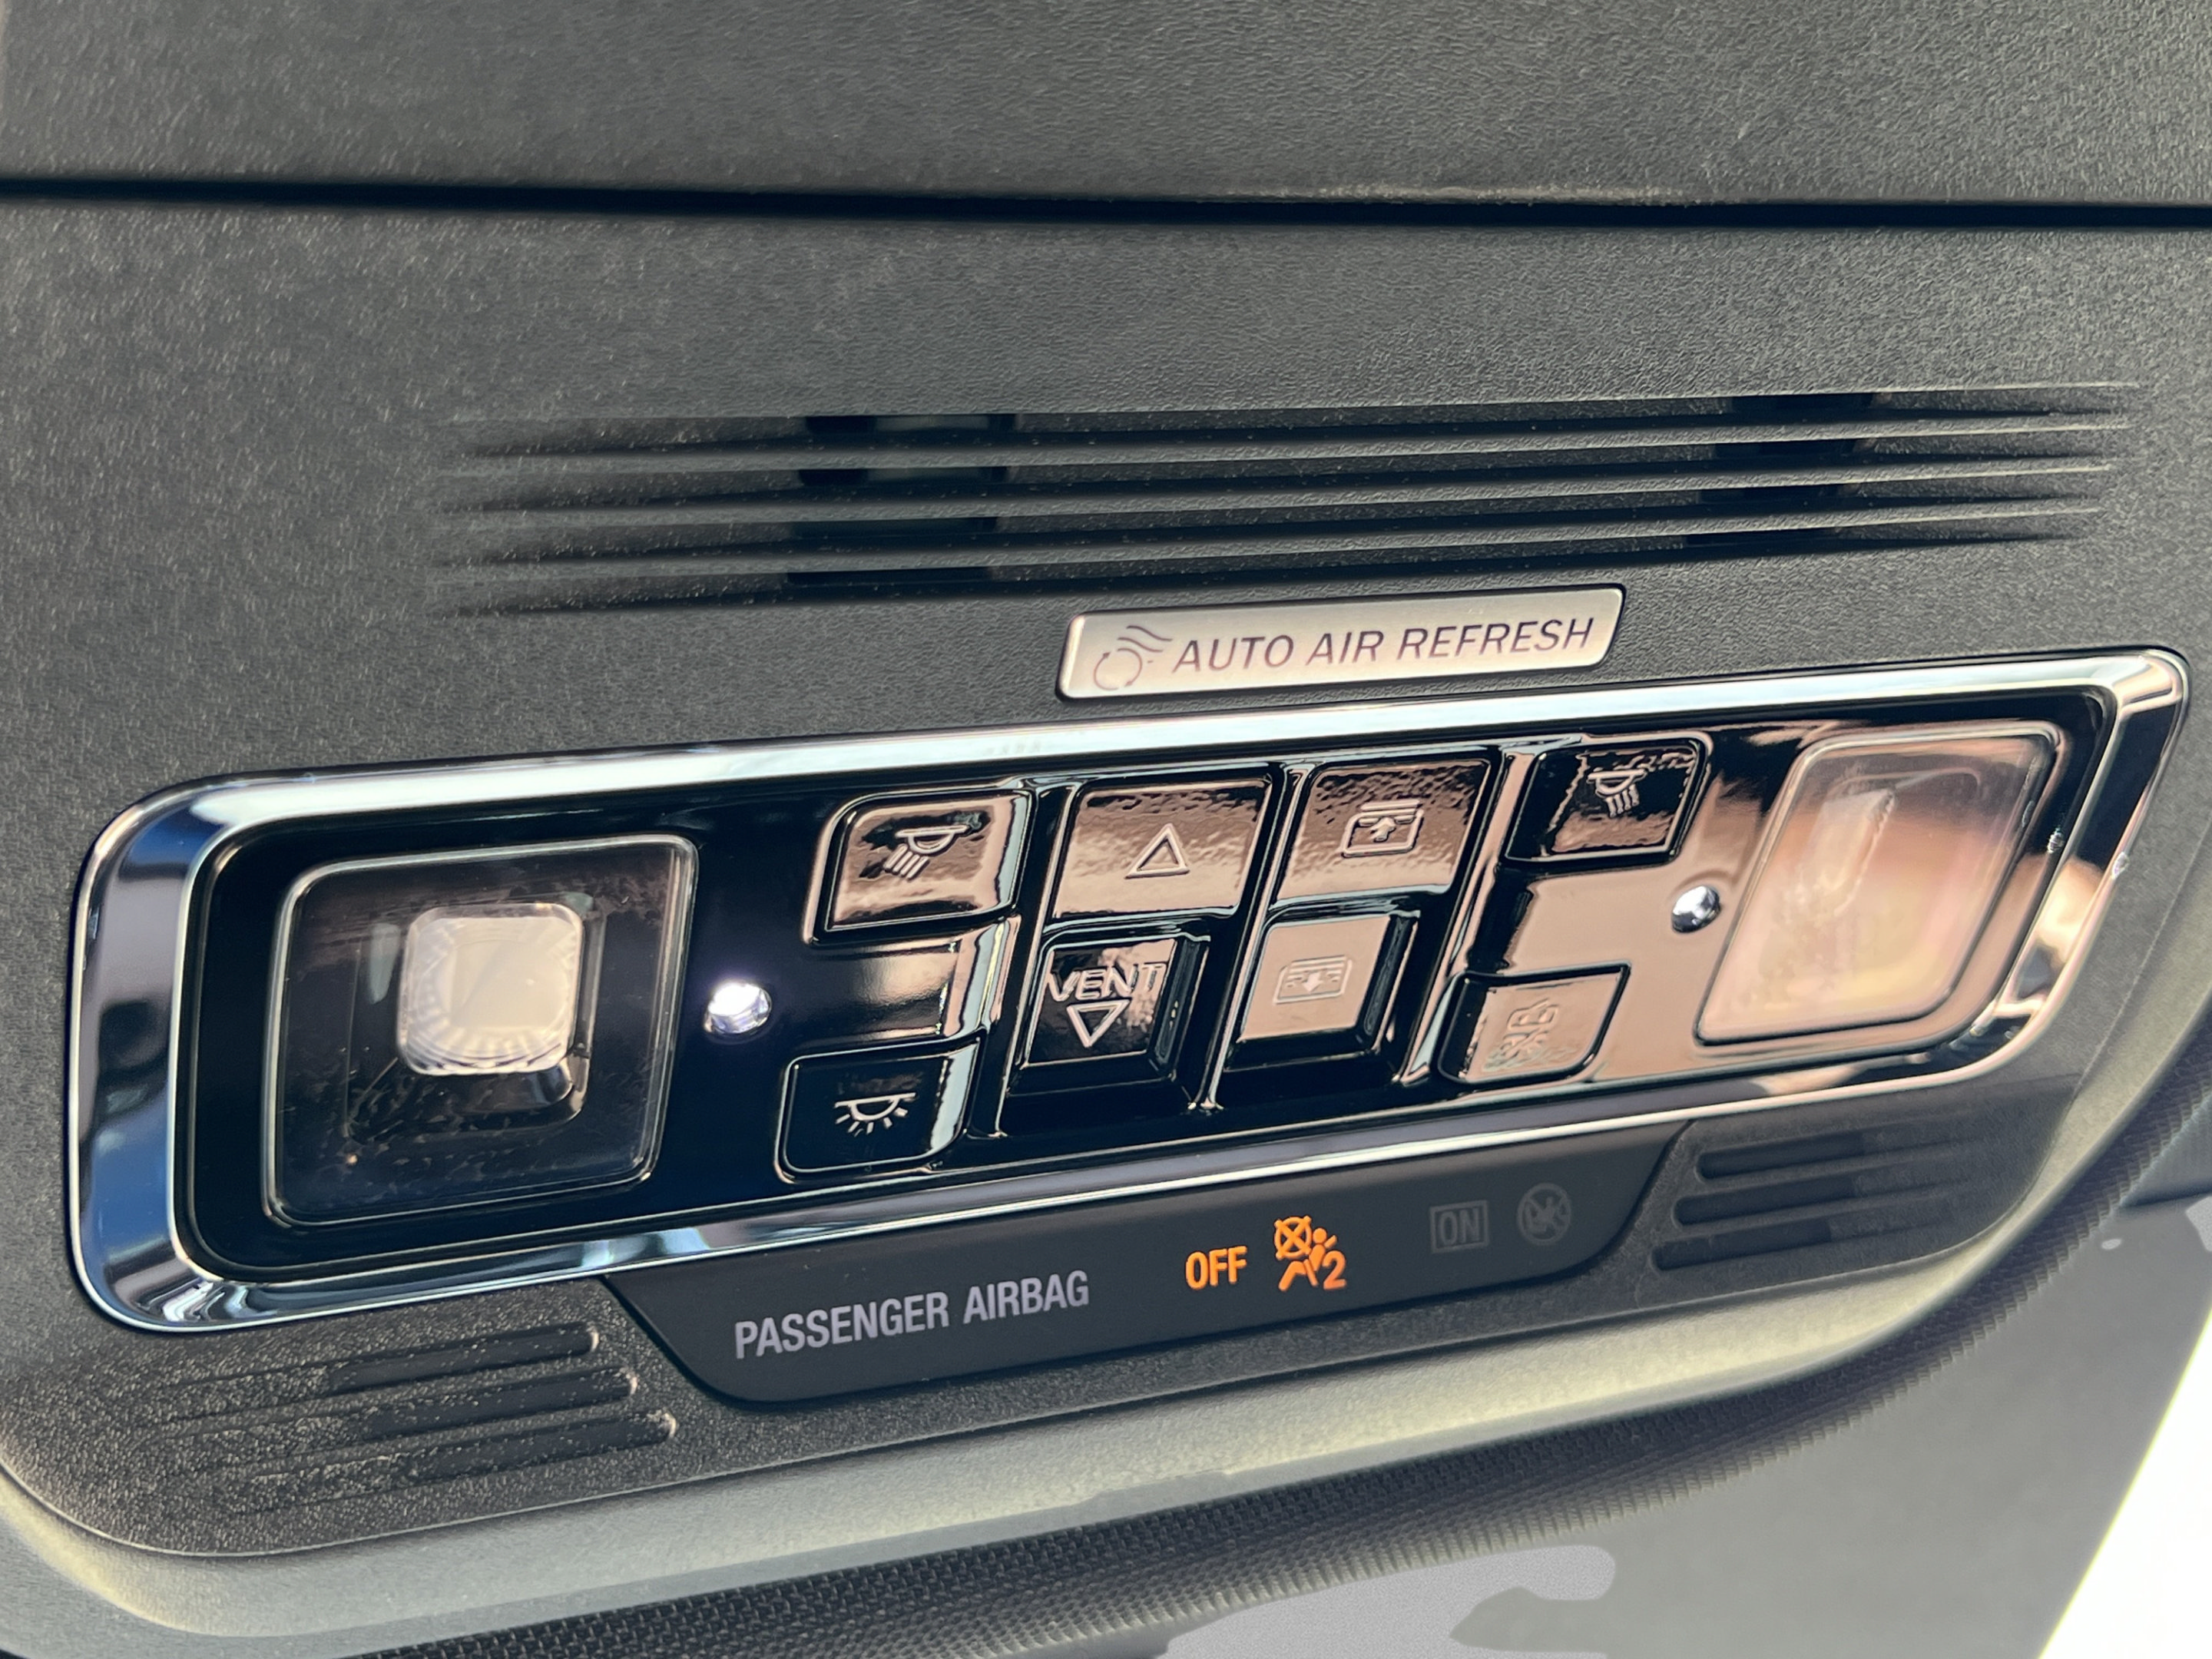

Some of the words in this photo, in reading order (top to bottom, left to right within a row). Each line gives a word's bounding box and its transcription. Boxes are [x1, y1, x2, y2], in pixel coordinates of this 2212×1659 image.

[1173, 634, 1293, 673] AUTO
[1306, 630, 1383, 666] AIR
[1396, 617, 1594, 661] REFRESH
[1050, 962, 1167, 1002] VENT
[1438, 1207, 1482, 1244] ON
[1186, 1246, 1247, 1290] OFF
[735, 1291, 949, 1359] PASSENGER
[963, 1270, 1089, 1323] AIRBAG
